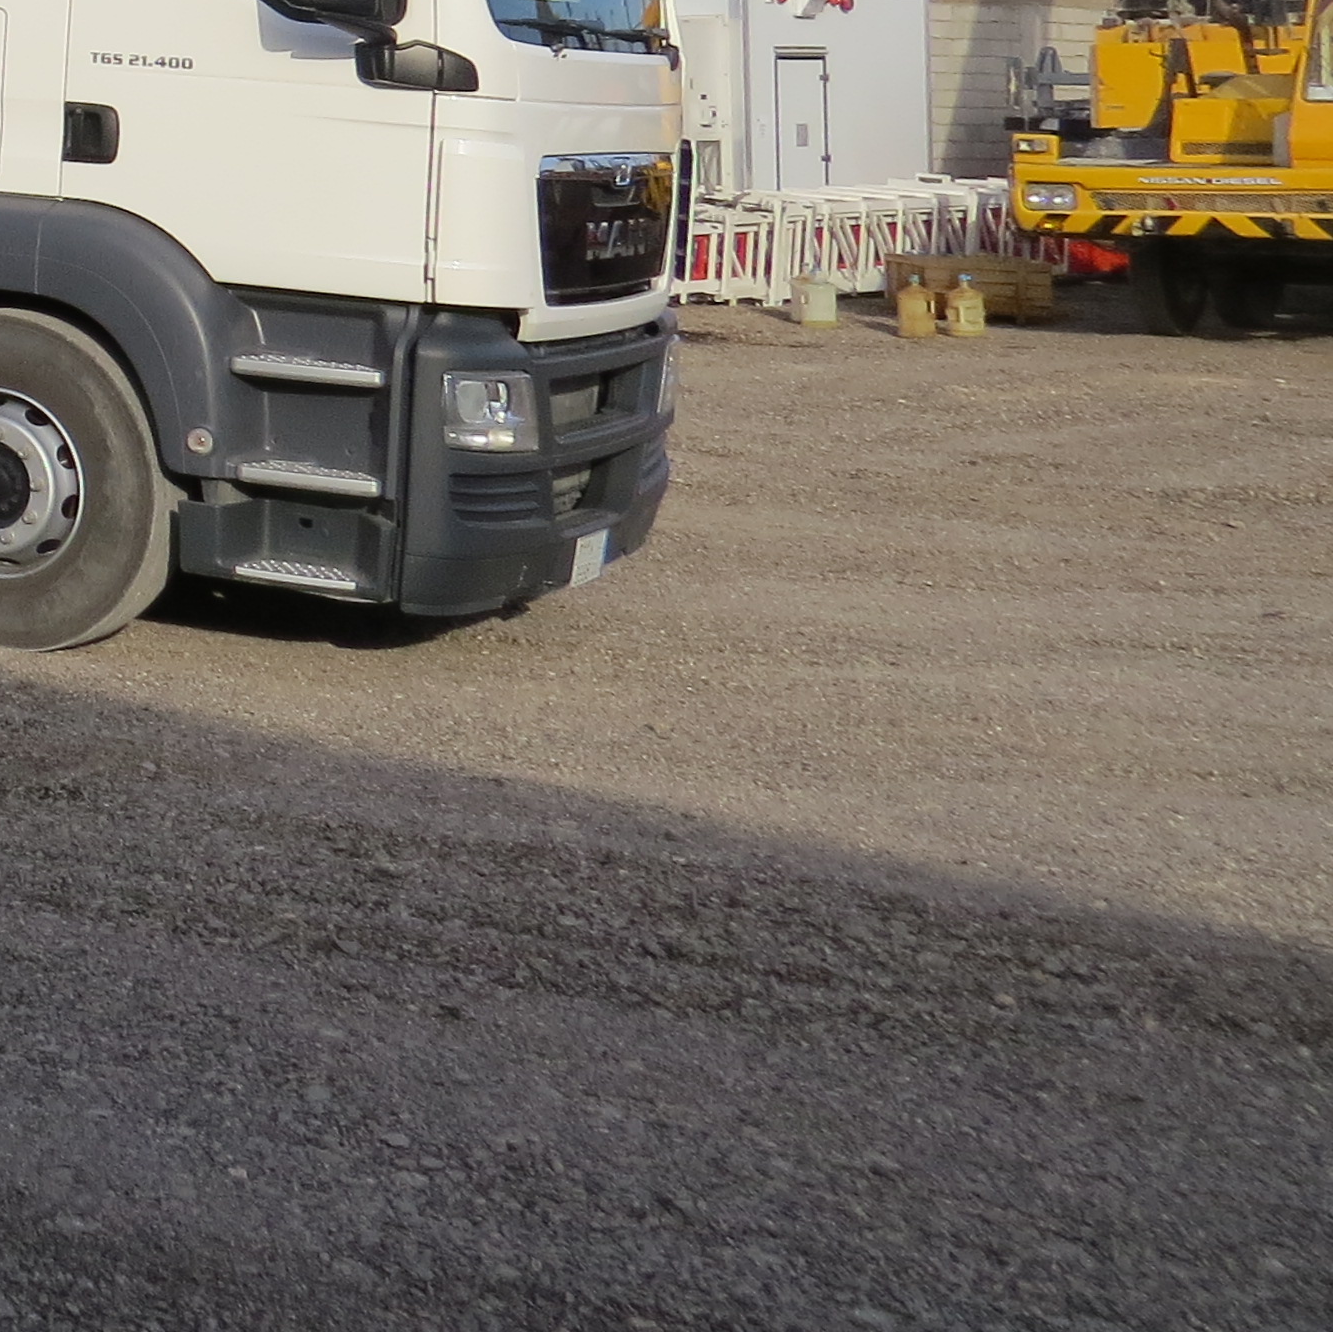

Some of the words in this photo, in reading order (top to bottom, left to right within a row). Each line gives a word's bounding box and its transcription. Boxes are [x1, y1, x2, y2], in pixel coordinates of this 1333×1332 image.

[90, 51, 123, 66] TGS
[128, 54, 194, 69] 21.400
[1138, 176, 1207, 186] NISSAN
[1212, 176, 1284, 186] DIESEL
